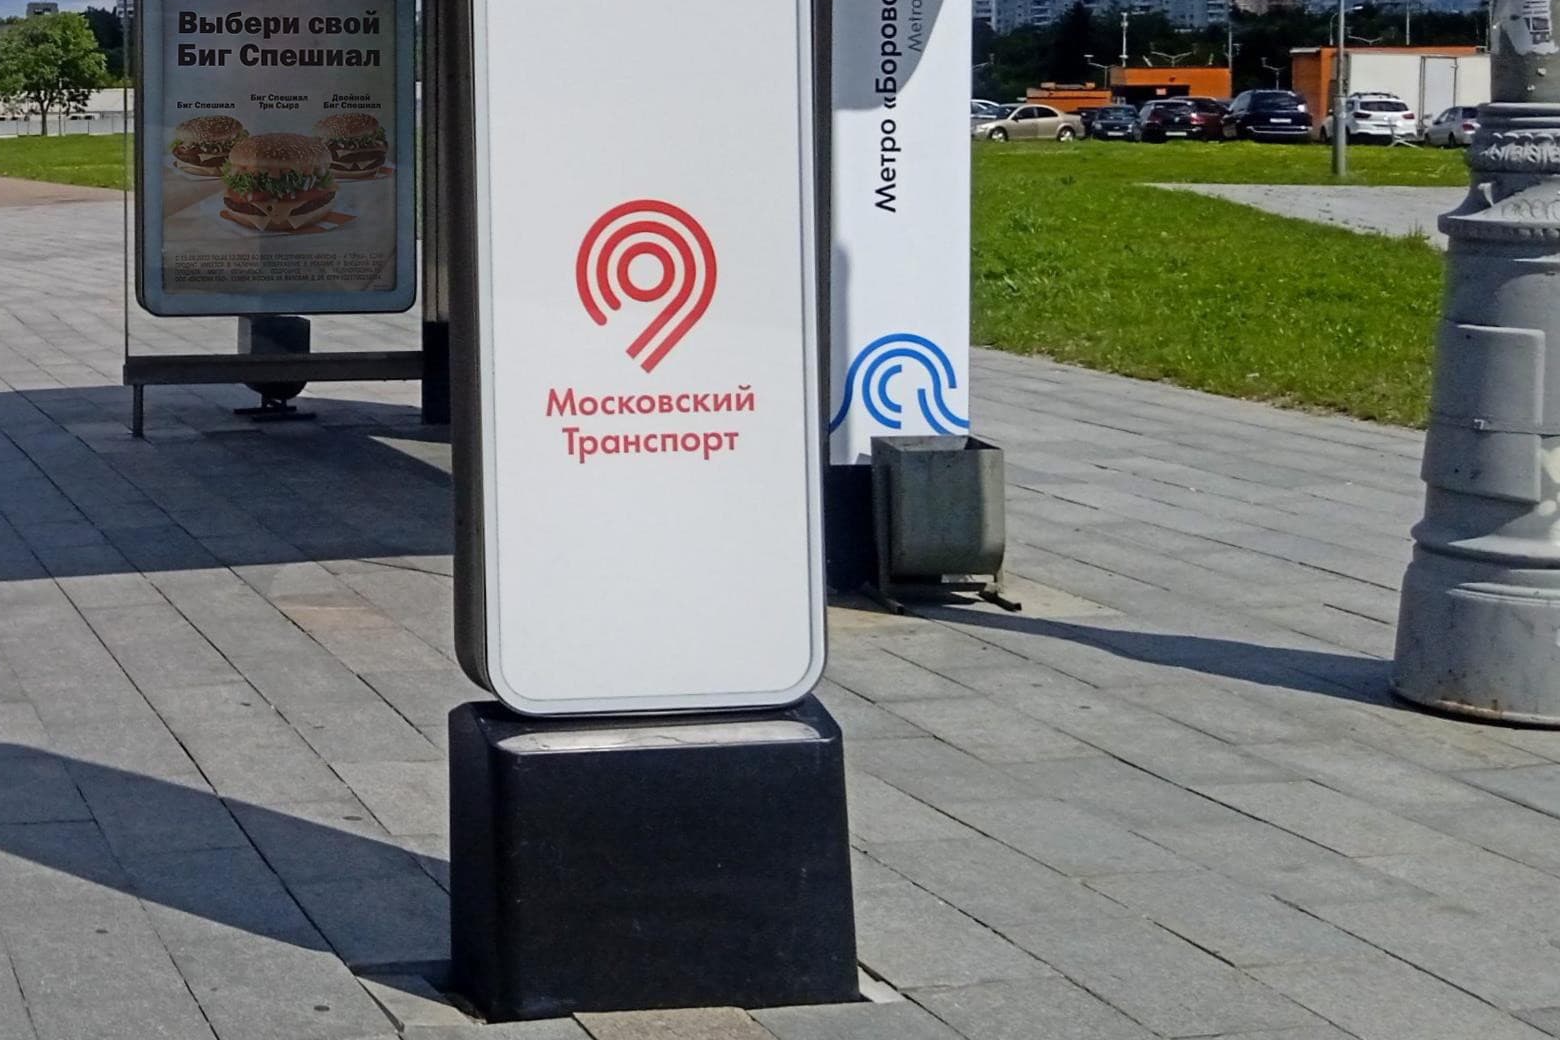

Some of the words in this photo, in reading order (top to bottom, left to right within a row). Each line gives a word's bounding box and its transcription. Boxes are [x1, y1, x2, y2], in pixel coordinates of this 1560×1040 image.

[178, 11, 300, 40] Выбери
[308, 10, 380, 34] свой
[178, 43, 233, 67] Биг
[240, 43, 381, 67] Спешиал
[177, 101, 193, 109] Биг
[195, 101, 235, 109] Спешиал
[251, 94, 266, 102] Биг
[268, 94, 308, 102] Спешиал
[323, 101, 339, 109] Биг
[341, 101, 381, 109] Спешиал
[331, 93, 370, 102] Двойной
[259, 102, 276, 110] Три
[875, 118, 902, 213] Метро
[546, 385, 756, 417] Московский
[562, 427, 739, 464] Транспорт
